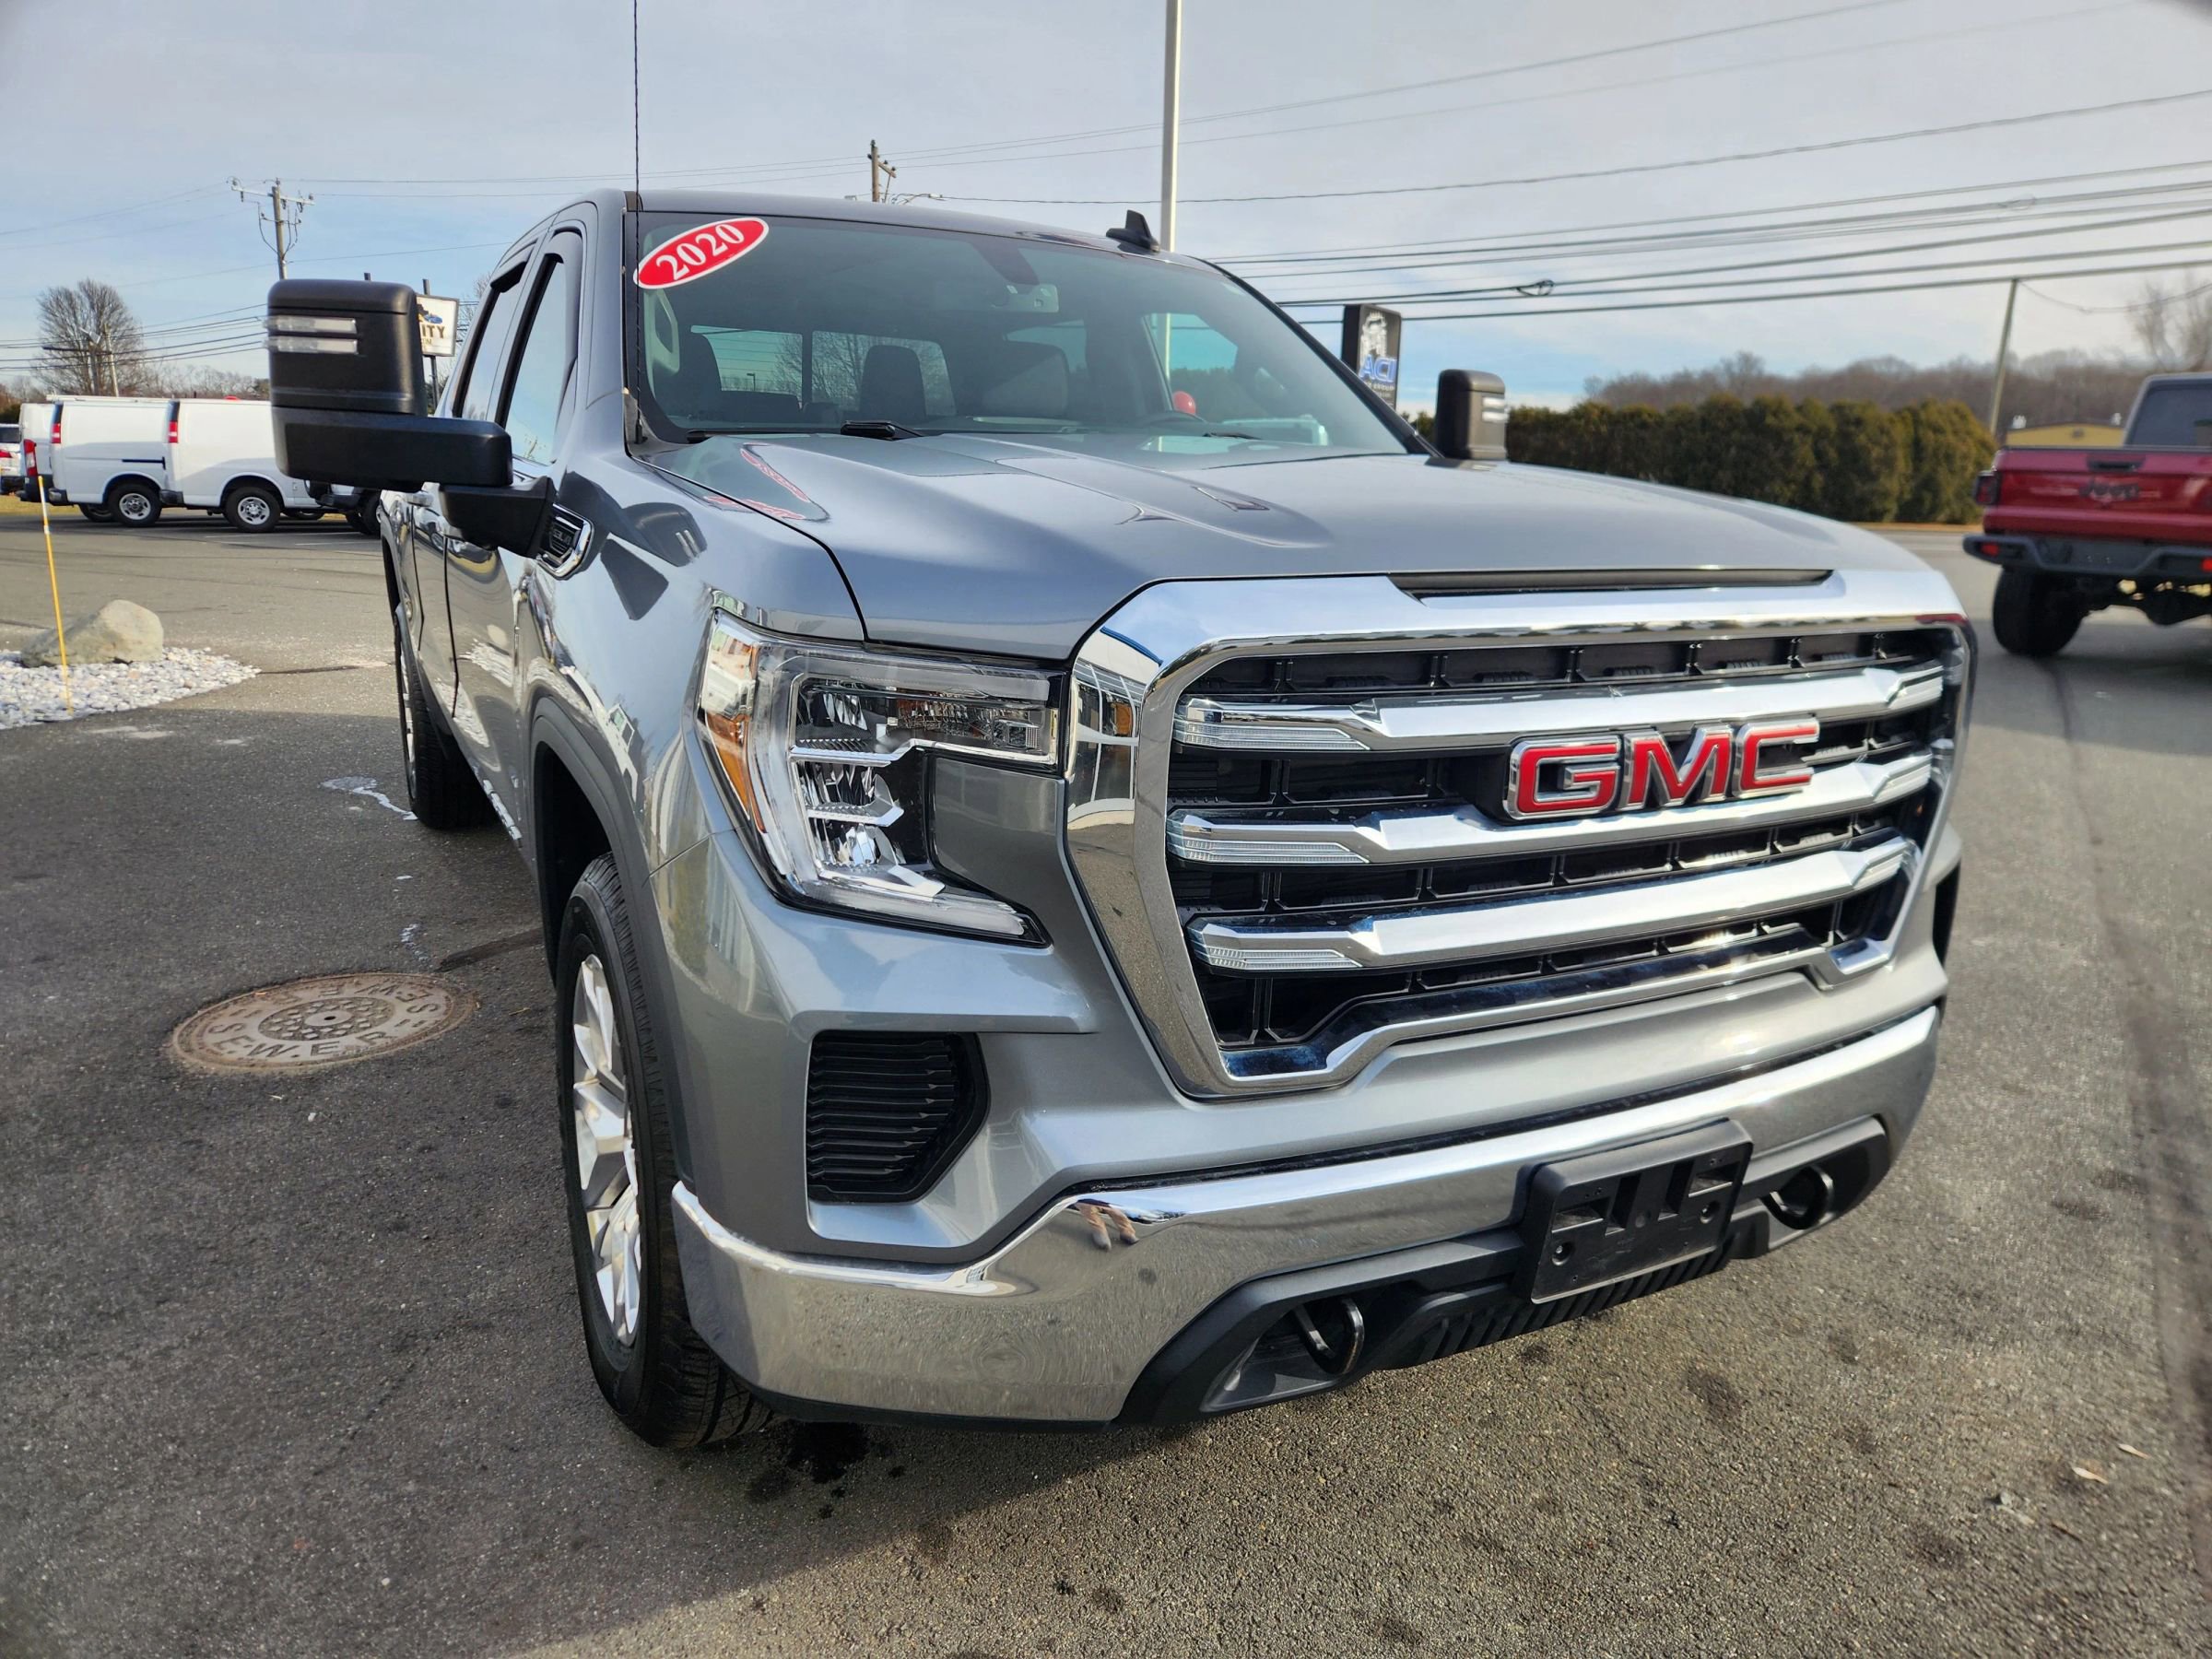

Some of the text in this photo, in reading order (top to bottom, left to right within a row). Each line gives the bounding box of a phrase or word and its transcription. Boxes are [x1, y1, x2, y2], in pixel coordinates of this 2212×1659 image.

[655, 224, 745, 281] 2020
[421, 324, 445, 339] ITY
[1503, 718, 1819, 820] GMC
[208, 1022, 399, 1059] SEWER
